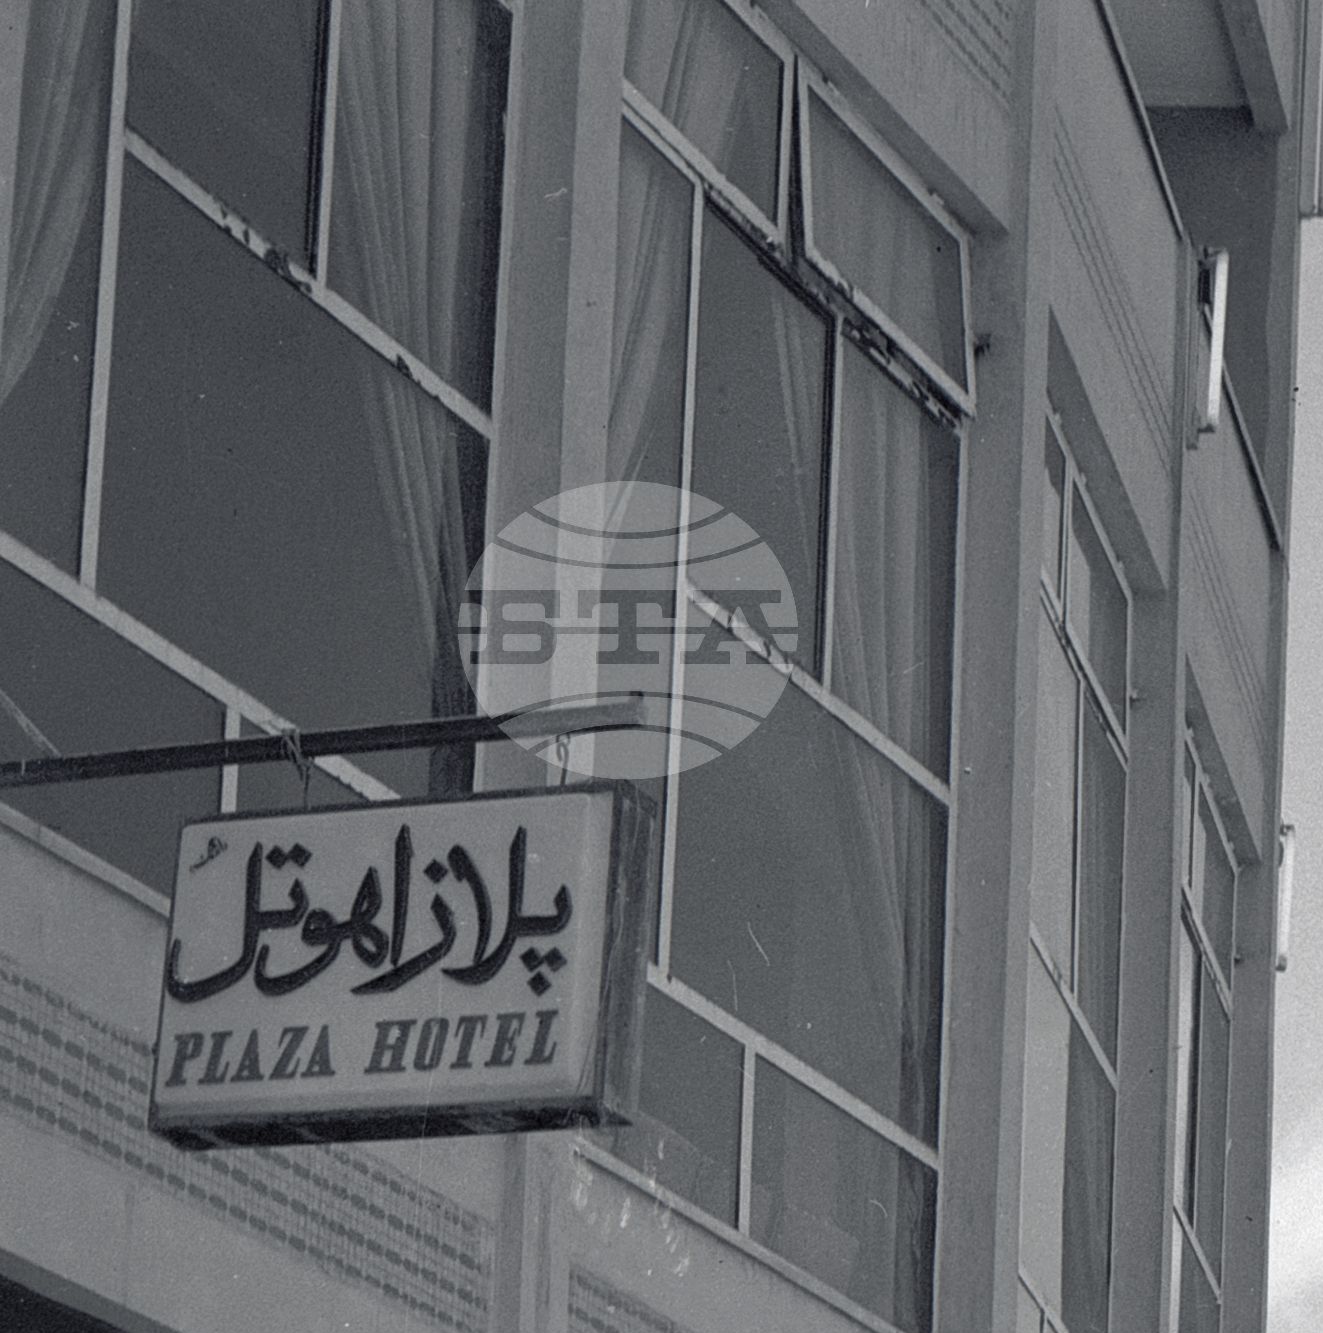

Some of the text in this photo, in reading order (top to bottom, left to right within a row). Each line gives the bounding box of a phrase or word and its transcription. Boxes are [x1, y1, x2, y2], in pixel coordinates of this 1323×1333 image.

[165, 840, 392, 1001] هوتل
[164, 1008, 559, 1088] PLAZA HOTEL
